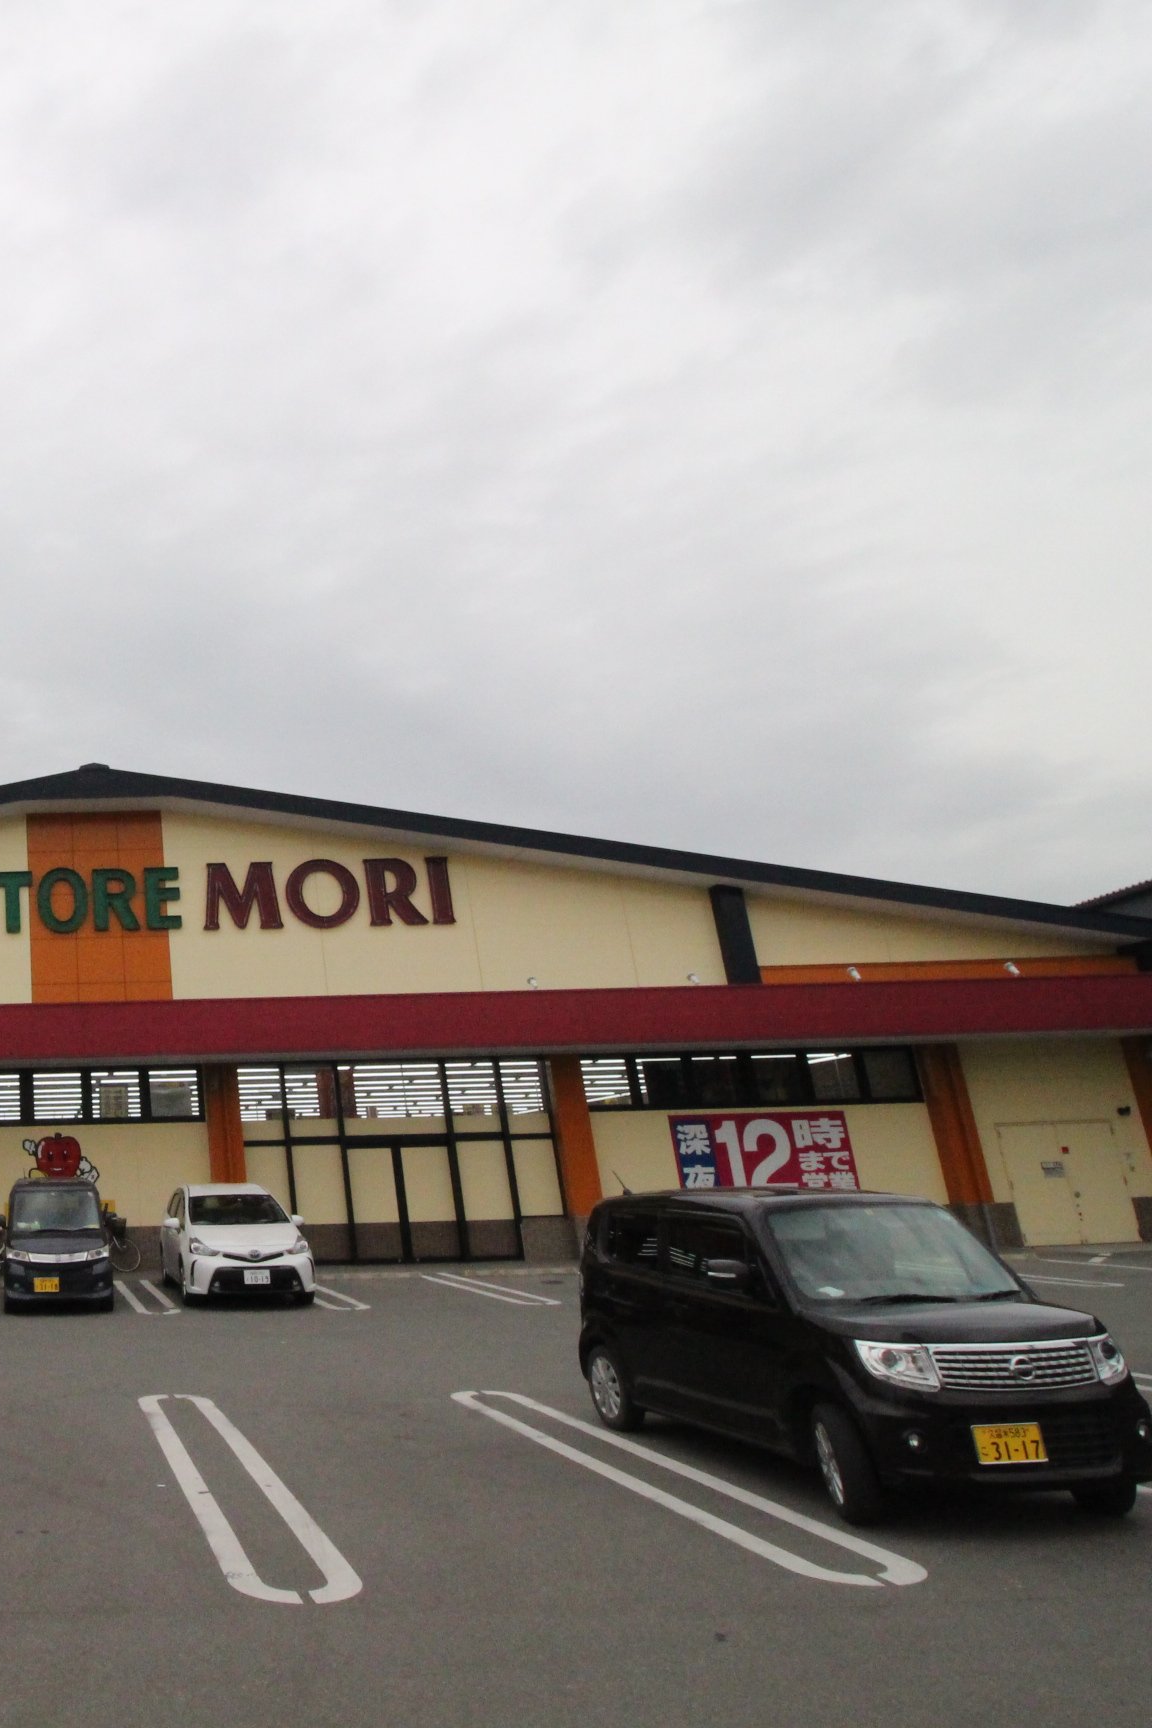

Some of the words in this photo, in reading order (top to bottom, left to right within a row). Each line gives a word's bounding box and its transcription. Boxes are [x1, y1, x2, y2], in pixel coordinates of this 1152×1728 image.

[203, 856, 457, 931] MORI
[676, 1124, 716, 1188] 深夜
[714, 1118, 799, 1187] 12
[791, 1117, 845, 1149] 時
[799, 1151, 850, 1170] まで
[990, 1440, 1040, 1461] 31-17
